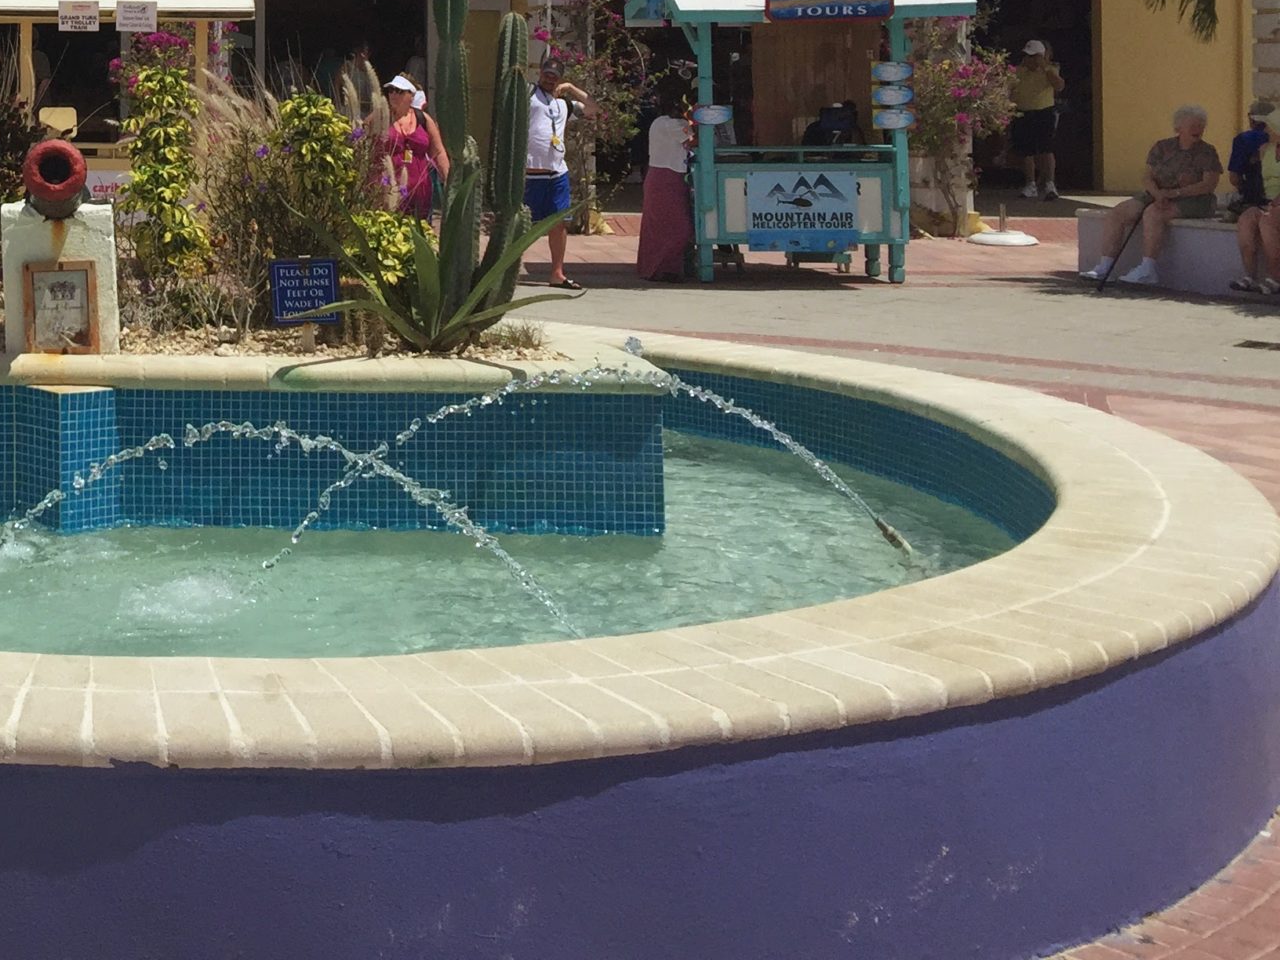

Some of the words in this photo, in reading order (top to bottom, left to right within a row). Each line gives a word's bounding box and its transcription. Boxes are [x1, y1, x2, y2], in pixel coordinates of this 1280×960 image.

[794, 5, 868, 16] TOURS
[752, 212, 827, 222] MOUNTAIN
[828, 212, 854, 222] AIR
[752, 221, 817, 229] HELICOPTER
[819, 221, 854, 229] TOURS
[279, 268, 310, 277] PLEASE
[303, 278, 330, 286] RINSE
[284, 300, 313, 308] WADE
